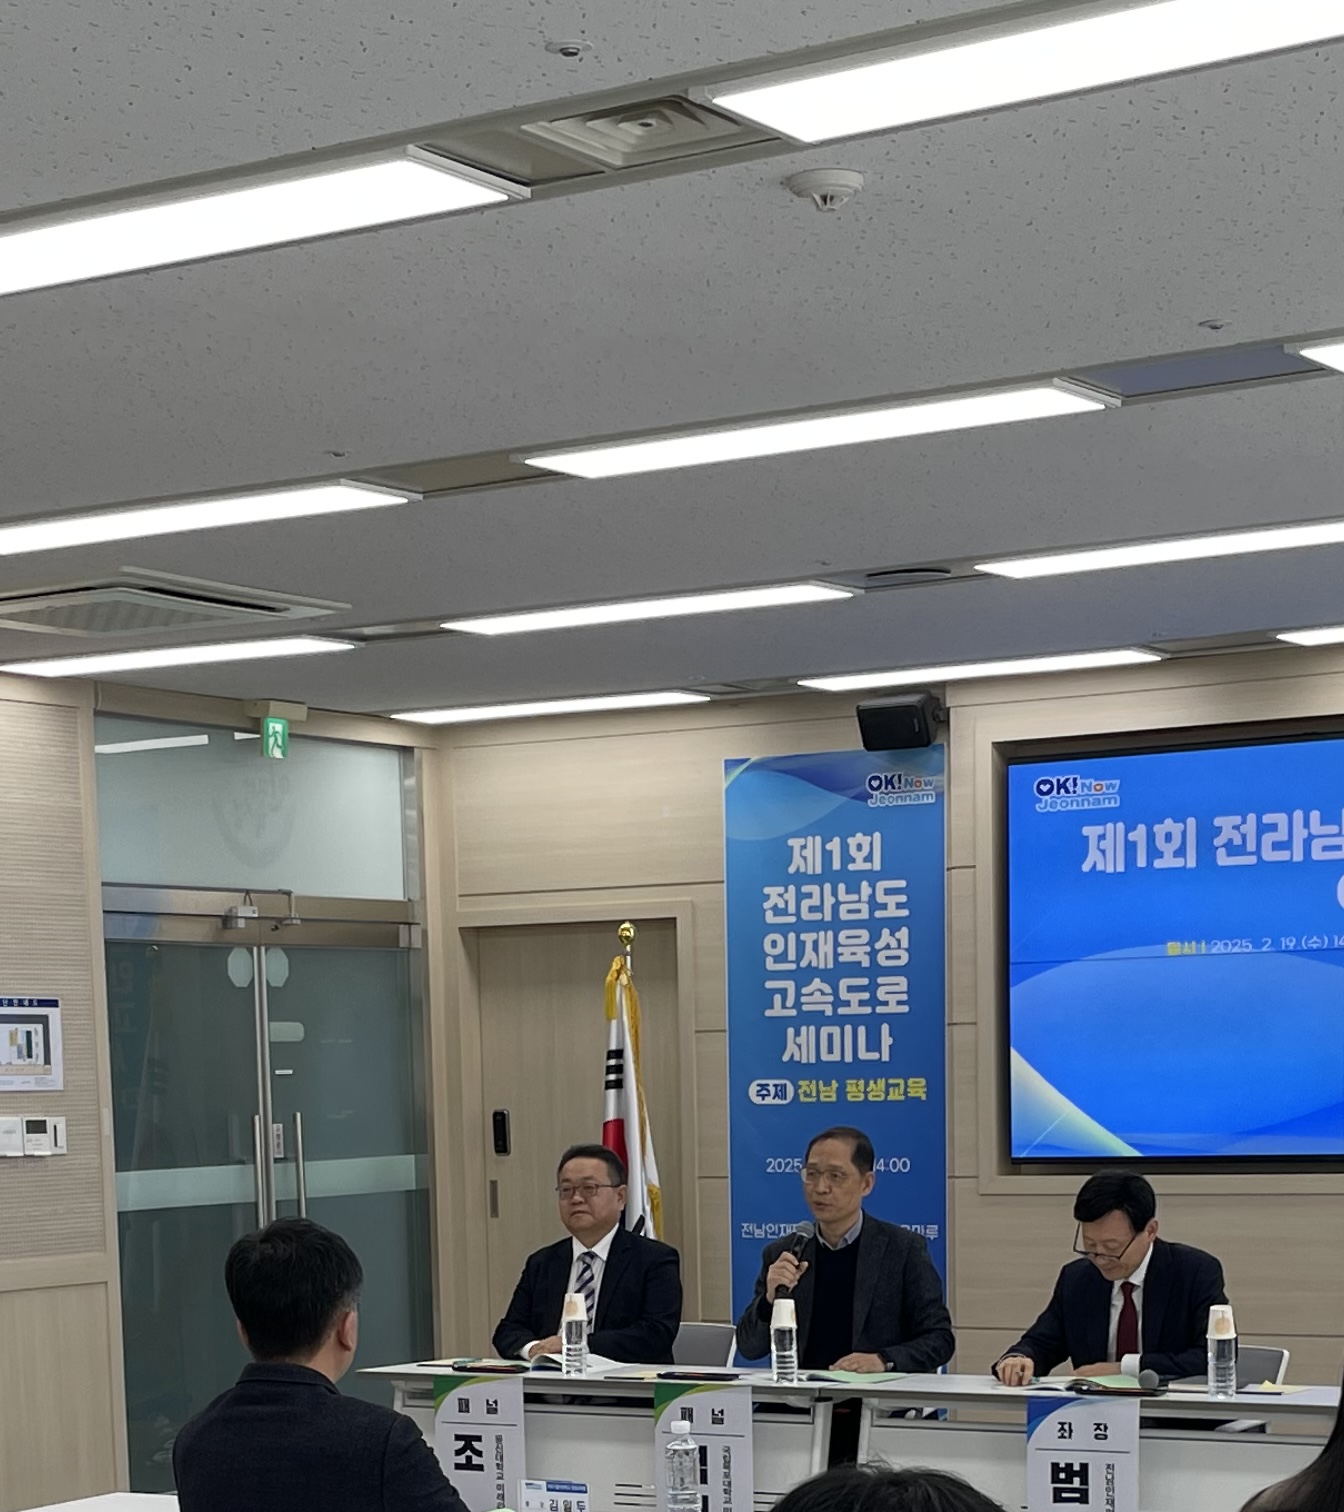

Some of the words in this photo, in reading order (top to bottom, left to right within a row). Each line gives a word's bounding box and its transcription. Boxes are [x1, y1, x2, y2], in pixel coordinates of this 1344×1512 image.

[867, 773, 903, 792] OK!
[787, 831, 883, 876] 제1회
[1080, 817, 1197, 874] 제1회
[762, 878, 910, 925] 전라남도
[762, 927, 910, 973] 인재육성
[763, 975, 910, 1018] 고속도로
[781, 1023, 894, 1064] 세미나
[755, 1082, 788, 1102] 주제
[797, 1078, 839, 1103] 전남
[844, 1077, 927, 1103] 평생교육
